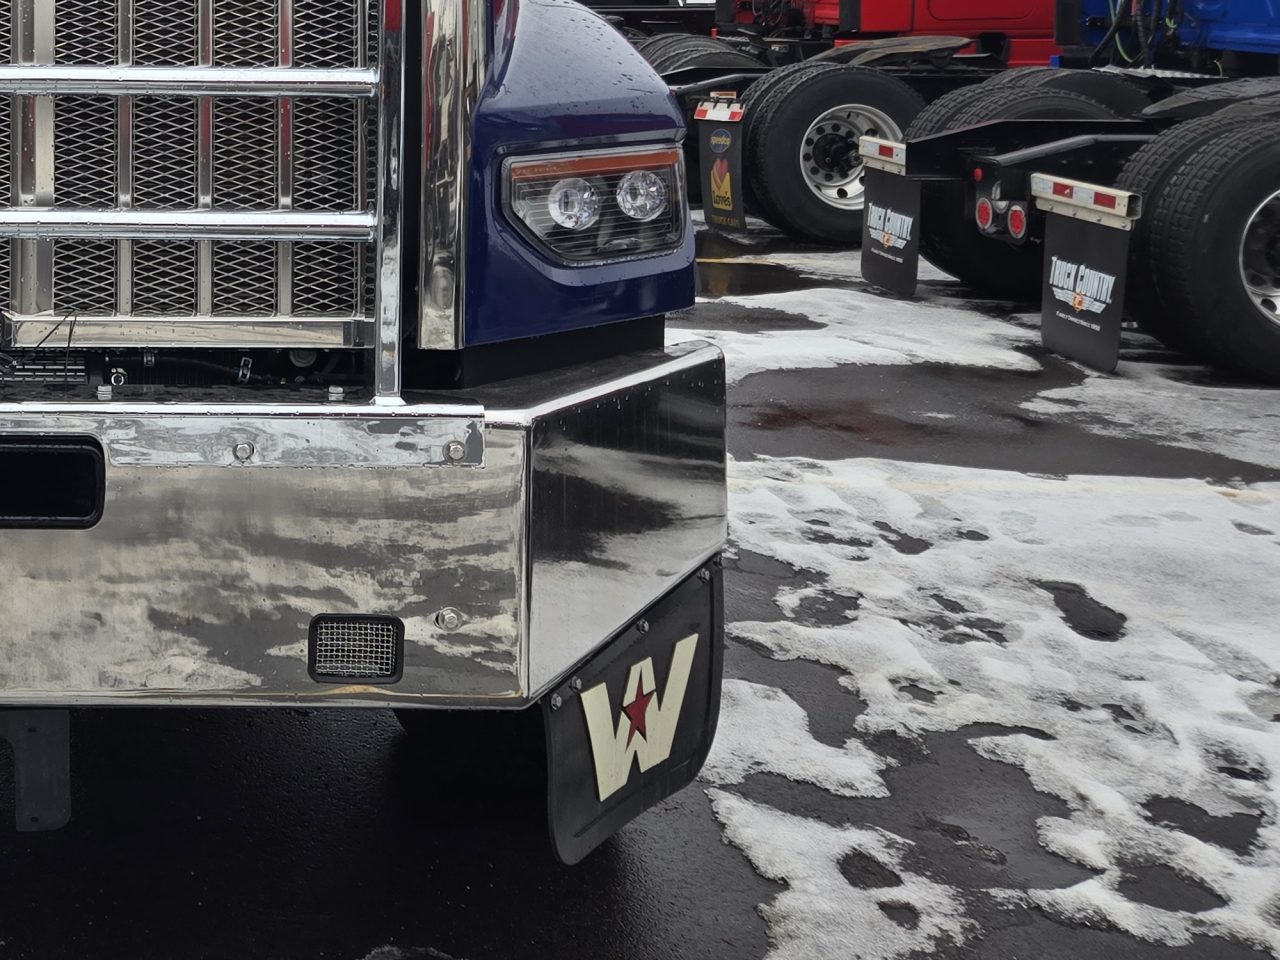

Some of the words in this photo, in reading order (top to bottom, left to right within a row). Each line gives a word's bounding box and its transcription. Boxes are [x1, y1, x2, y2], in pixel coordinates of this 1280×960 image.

[867, 202, 886, 231] TRUCK
[883, 208, 914, 241] COUNTRY
[1049, 256, 1078, 291] TRUCK
[1074, 264, 1116, 304] COUNTRY
